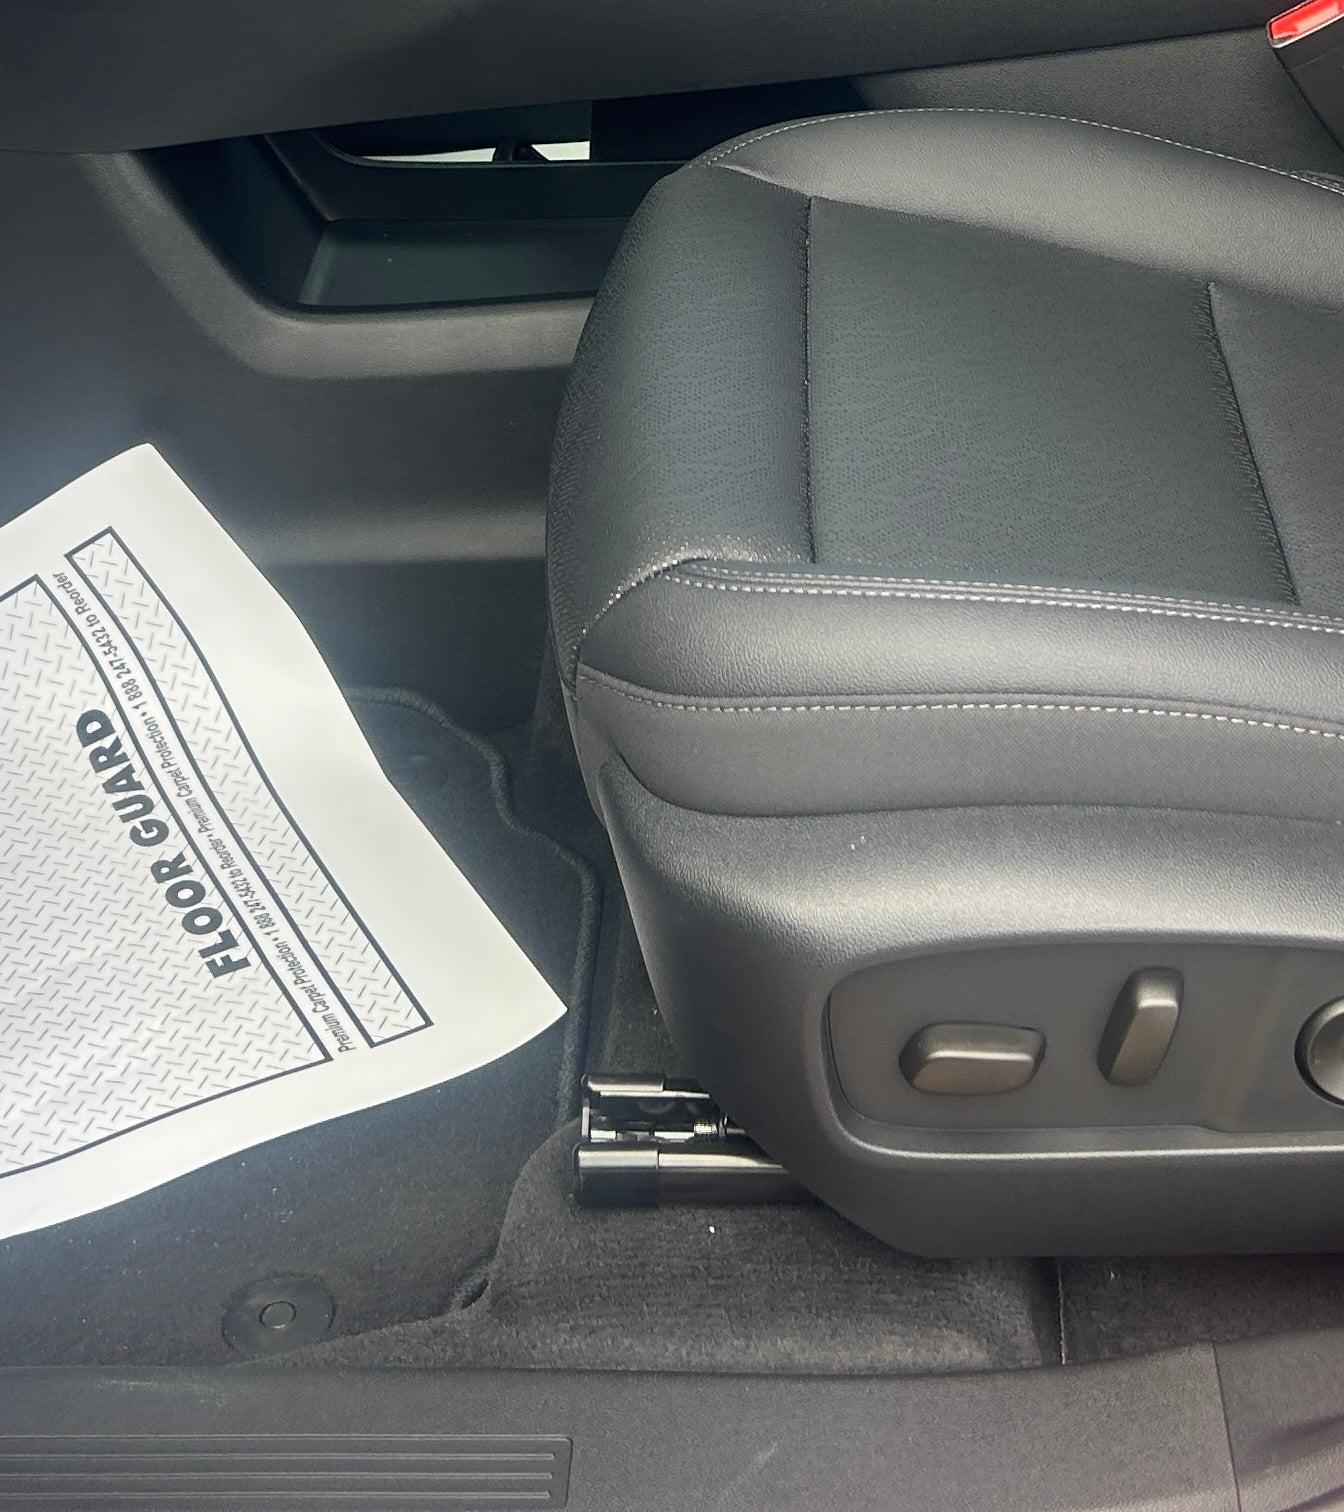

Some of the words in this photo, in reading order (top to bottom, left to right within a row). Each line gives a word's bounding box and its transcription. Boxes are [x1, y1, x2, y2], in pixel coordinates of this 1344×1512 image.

[53, 571, 91, 615] Reorder
[86, 612, 101, 628] to
[121, 678, 143, 702] 888
[142, 715, 177, 770] Protection
[76, 709, 170, 848] GUARD
[166, 767, 193, 798] Carpet
[185, 797, 216, 834] Premium
[209, 838, 237, 870] Reorder
[150, 851, 251, 979] FLOOR
[274, 941, 312, 988] Protection
[304, 984, 330, 1013] Carpet
[322, 1013, 357, 1052] Premium
